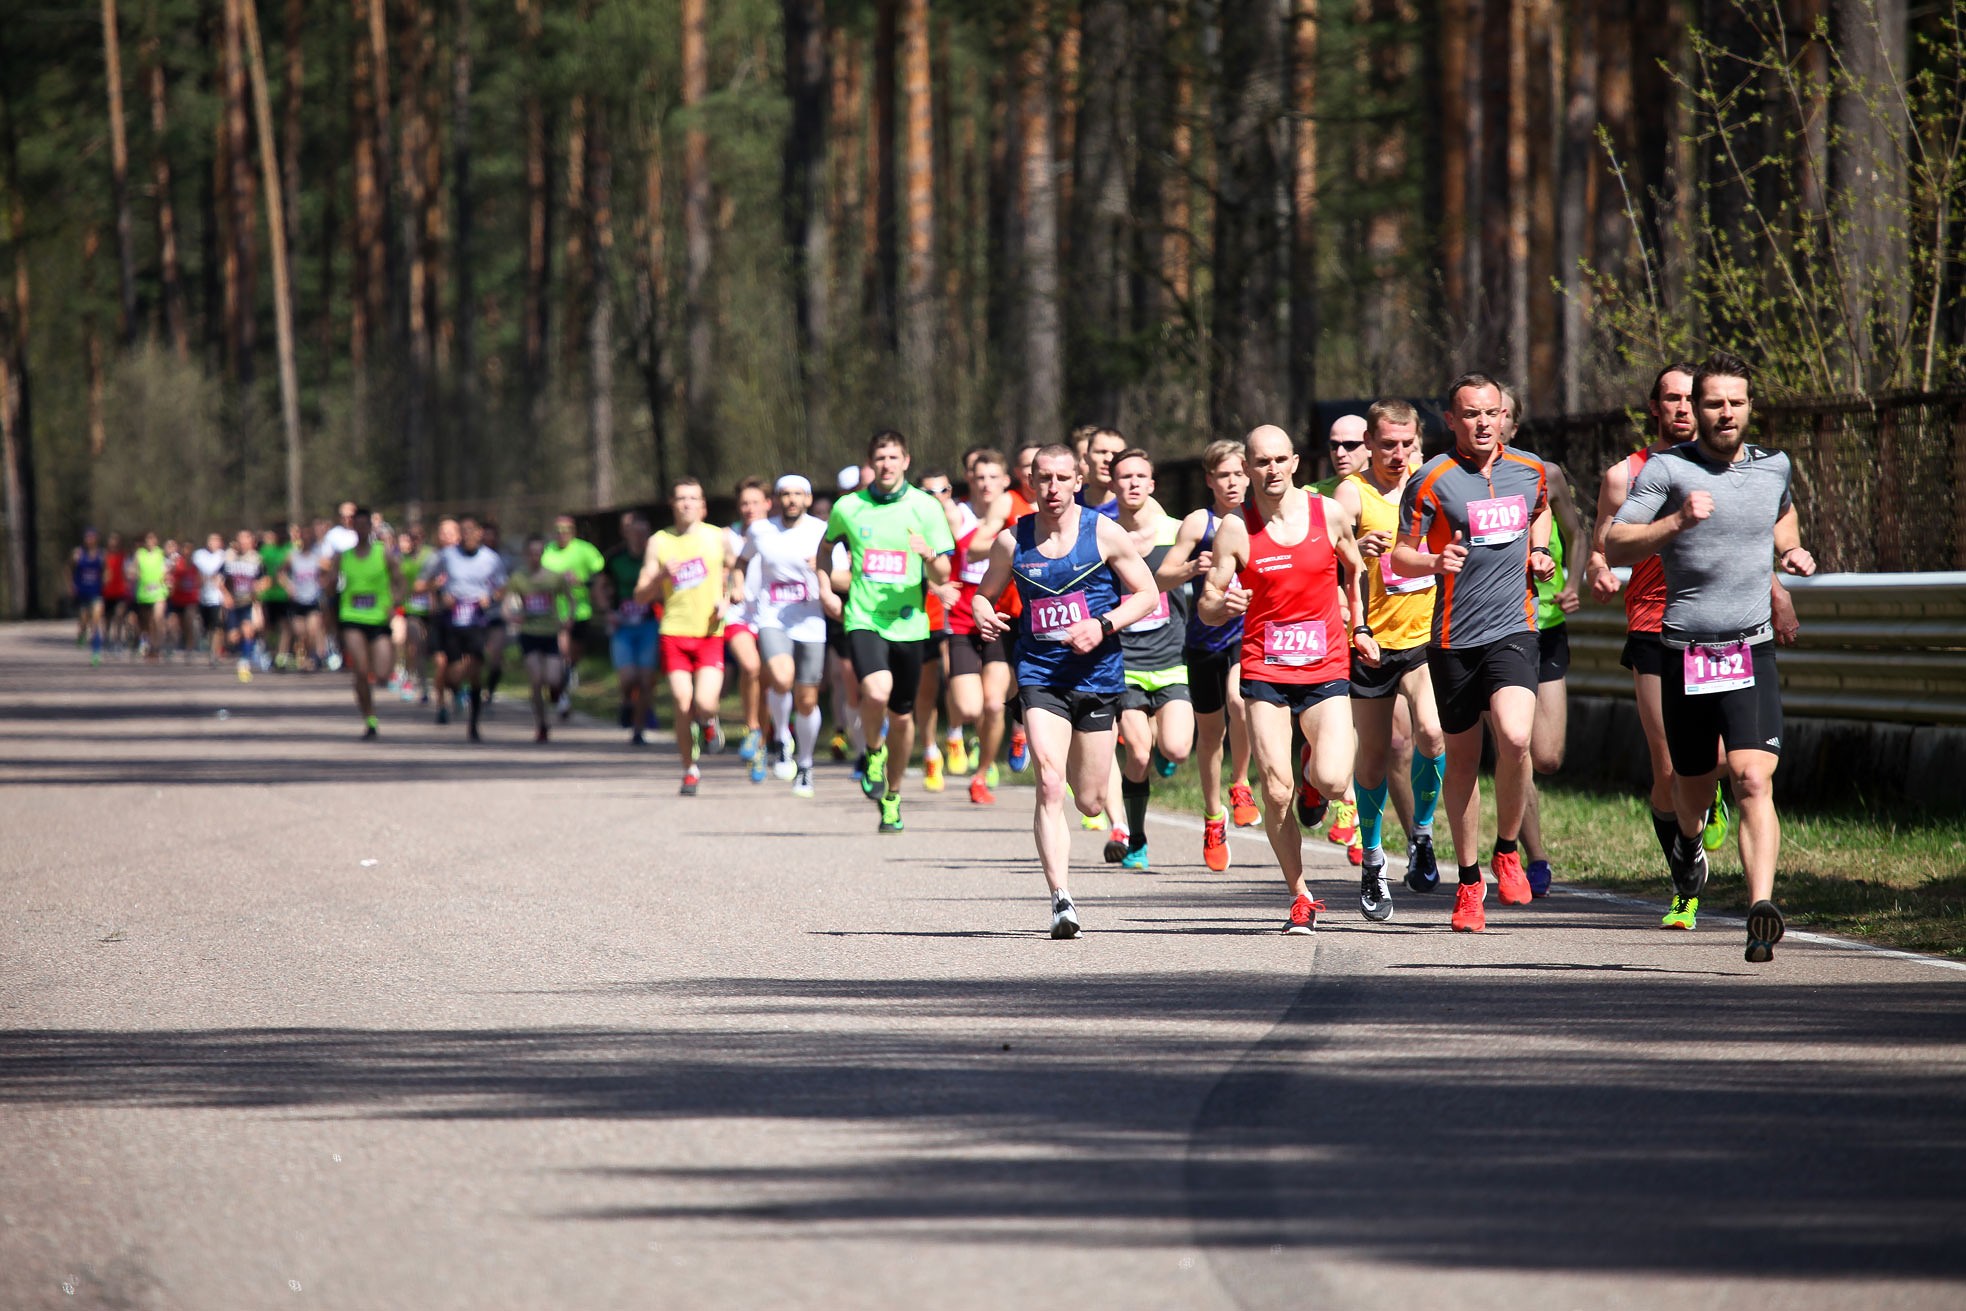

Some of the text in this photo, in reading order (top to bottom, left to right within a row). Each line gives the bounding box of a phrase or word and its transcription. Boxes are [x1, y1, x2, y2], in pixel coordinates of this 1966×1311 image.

[1476, 505, 1521, 530] 2209
[1039, 601, 1082, 629] 1220
[1273, 630, 1319, 651] 2294
[1694, 653, 1745, 678] 1182
